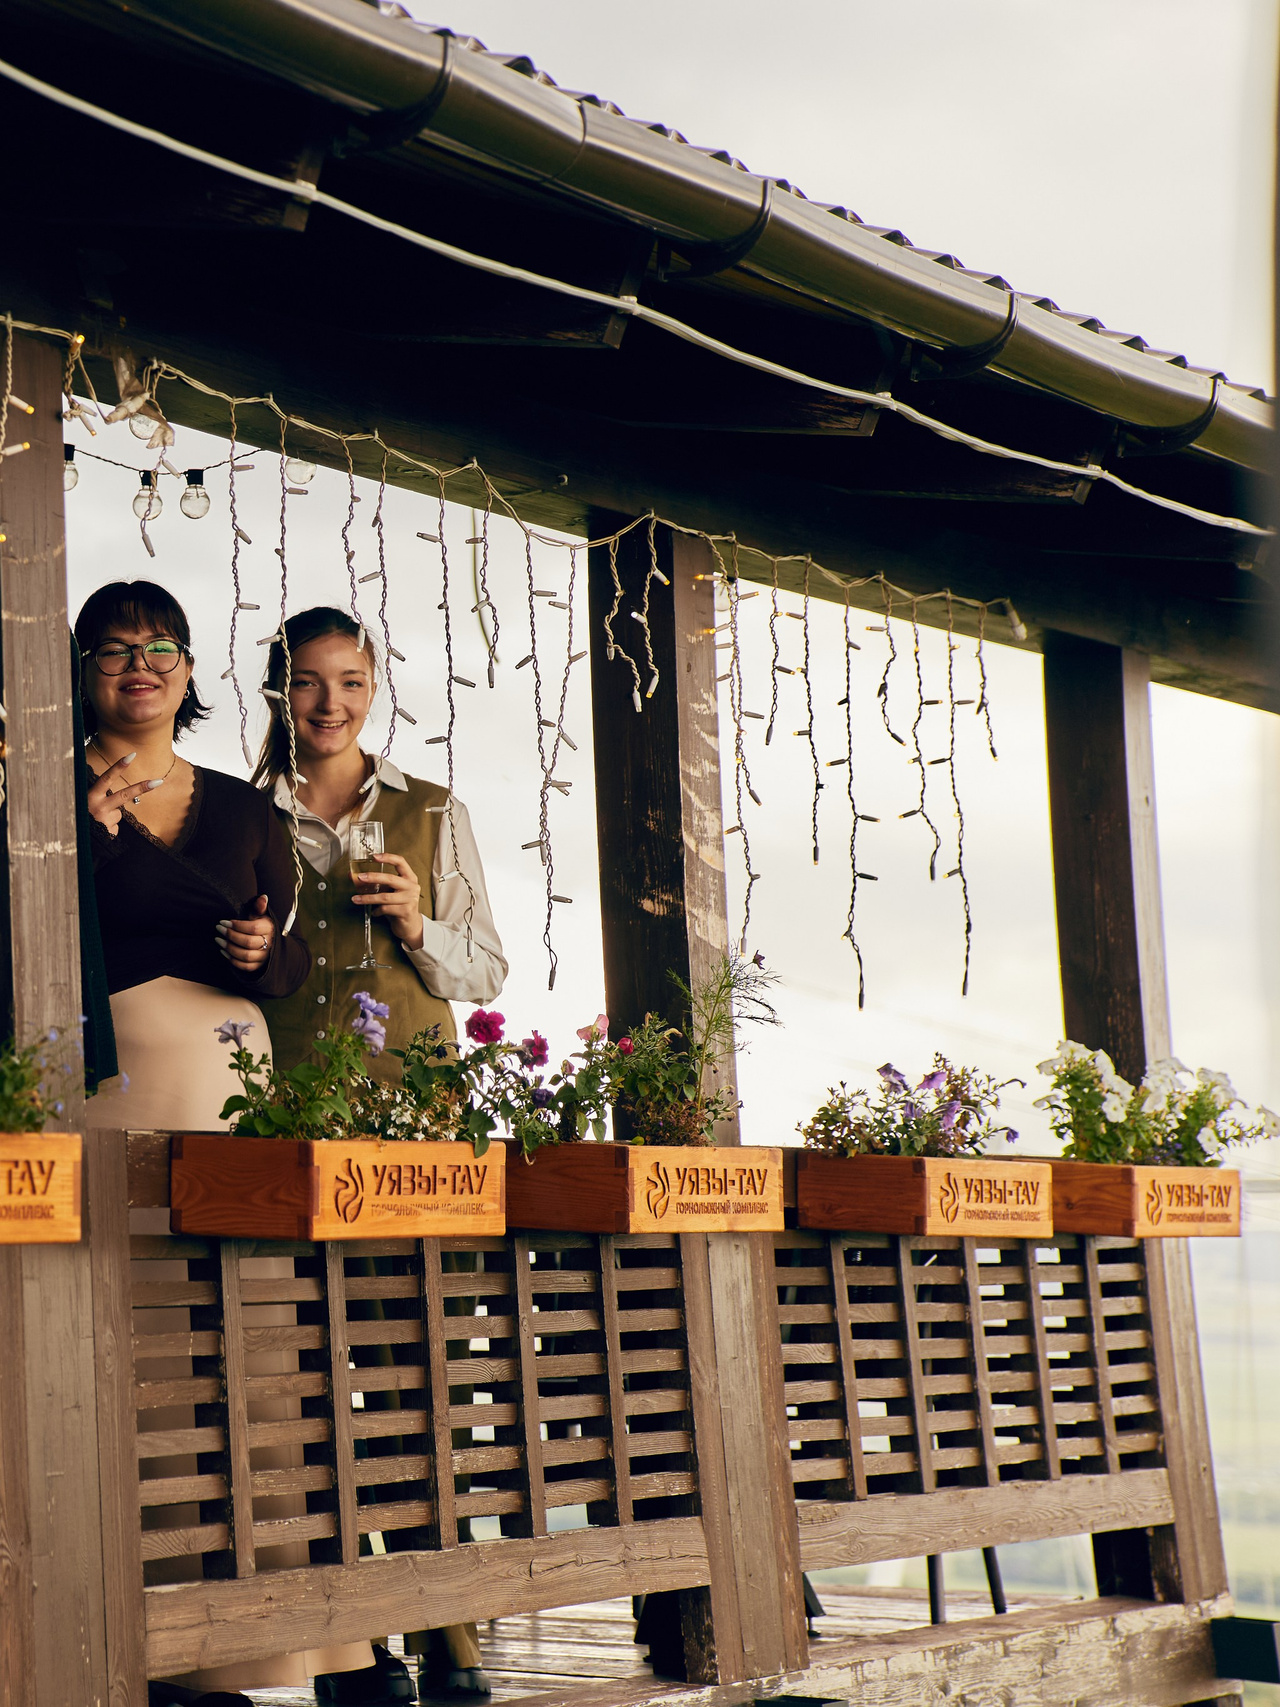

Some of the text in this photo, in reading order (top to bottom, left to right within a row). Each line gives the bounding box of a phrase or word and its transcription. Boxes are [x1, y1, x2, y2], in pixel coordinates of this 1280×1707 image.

[371, 1165, 488, 1195] УЯЗЫ-ТАУ
[675, 1167, 768, 1195] УЯЗЫ-ТАУ
[964, 1178, 1040, 1205] УЯЗЫ-ТАУ
[1166, 1184, 1232, 1207] УЯЗЫ-ТАУ
